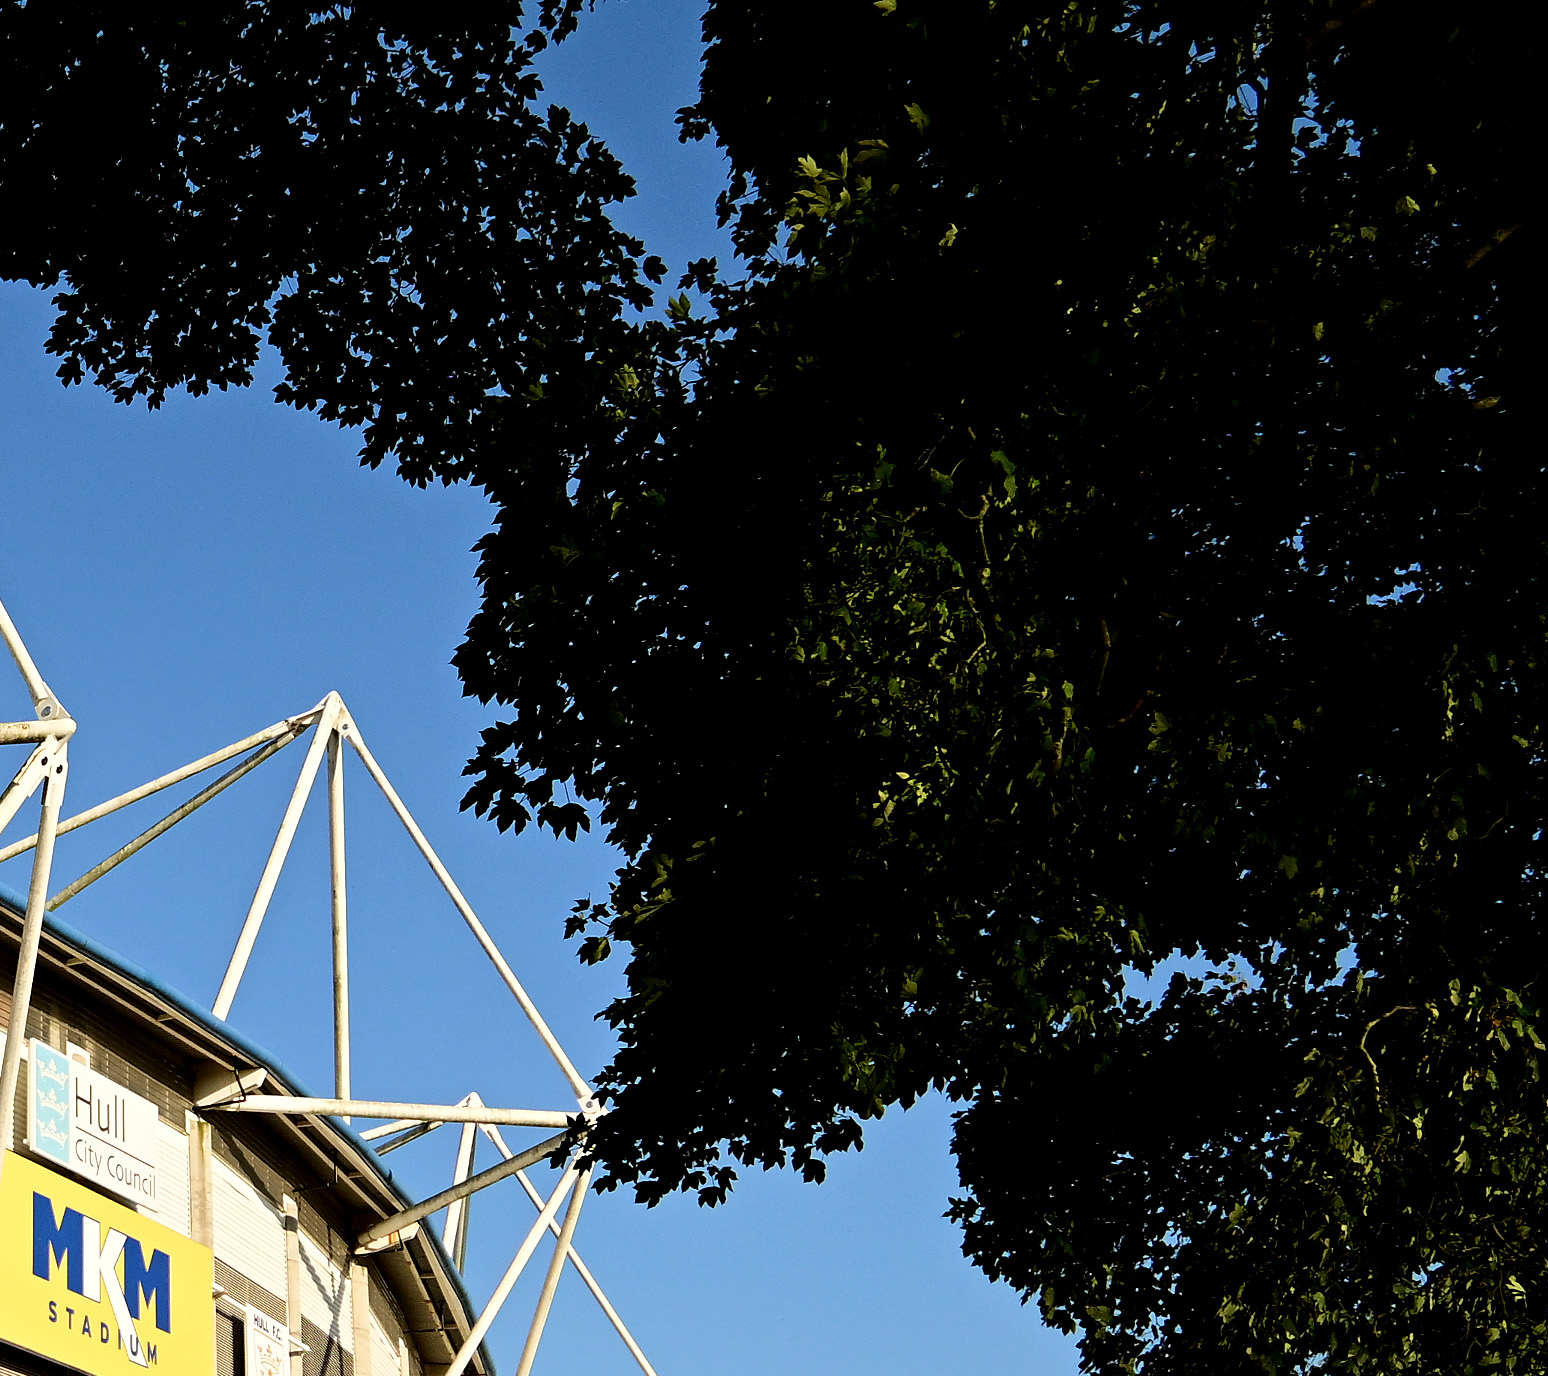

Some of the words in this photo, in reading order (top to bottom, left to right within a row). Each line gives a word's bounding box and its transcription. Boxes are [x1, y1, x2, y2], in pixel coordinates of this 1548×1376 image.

[75, 1077, 126, 1143] Hull
[75, 1139, 103, 1176] City
[107, 1155, 156, 1199] Council
[33, 1191, 171, 1368] MKM
[48, 1300, 158, 1366] STADIUM
